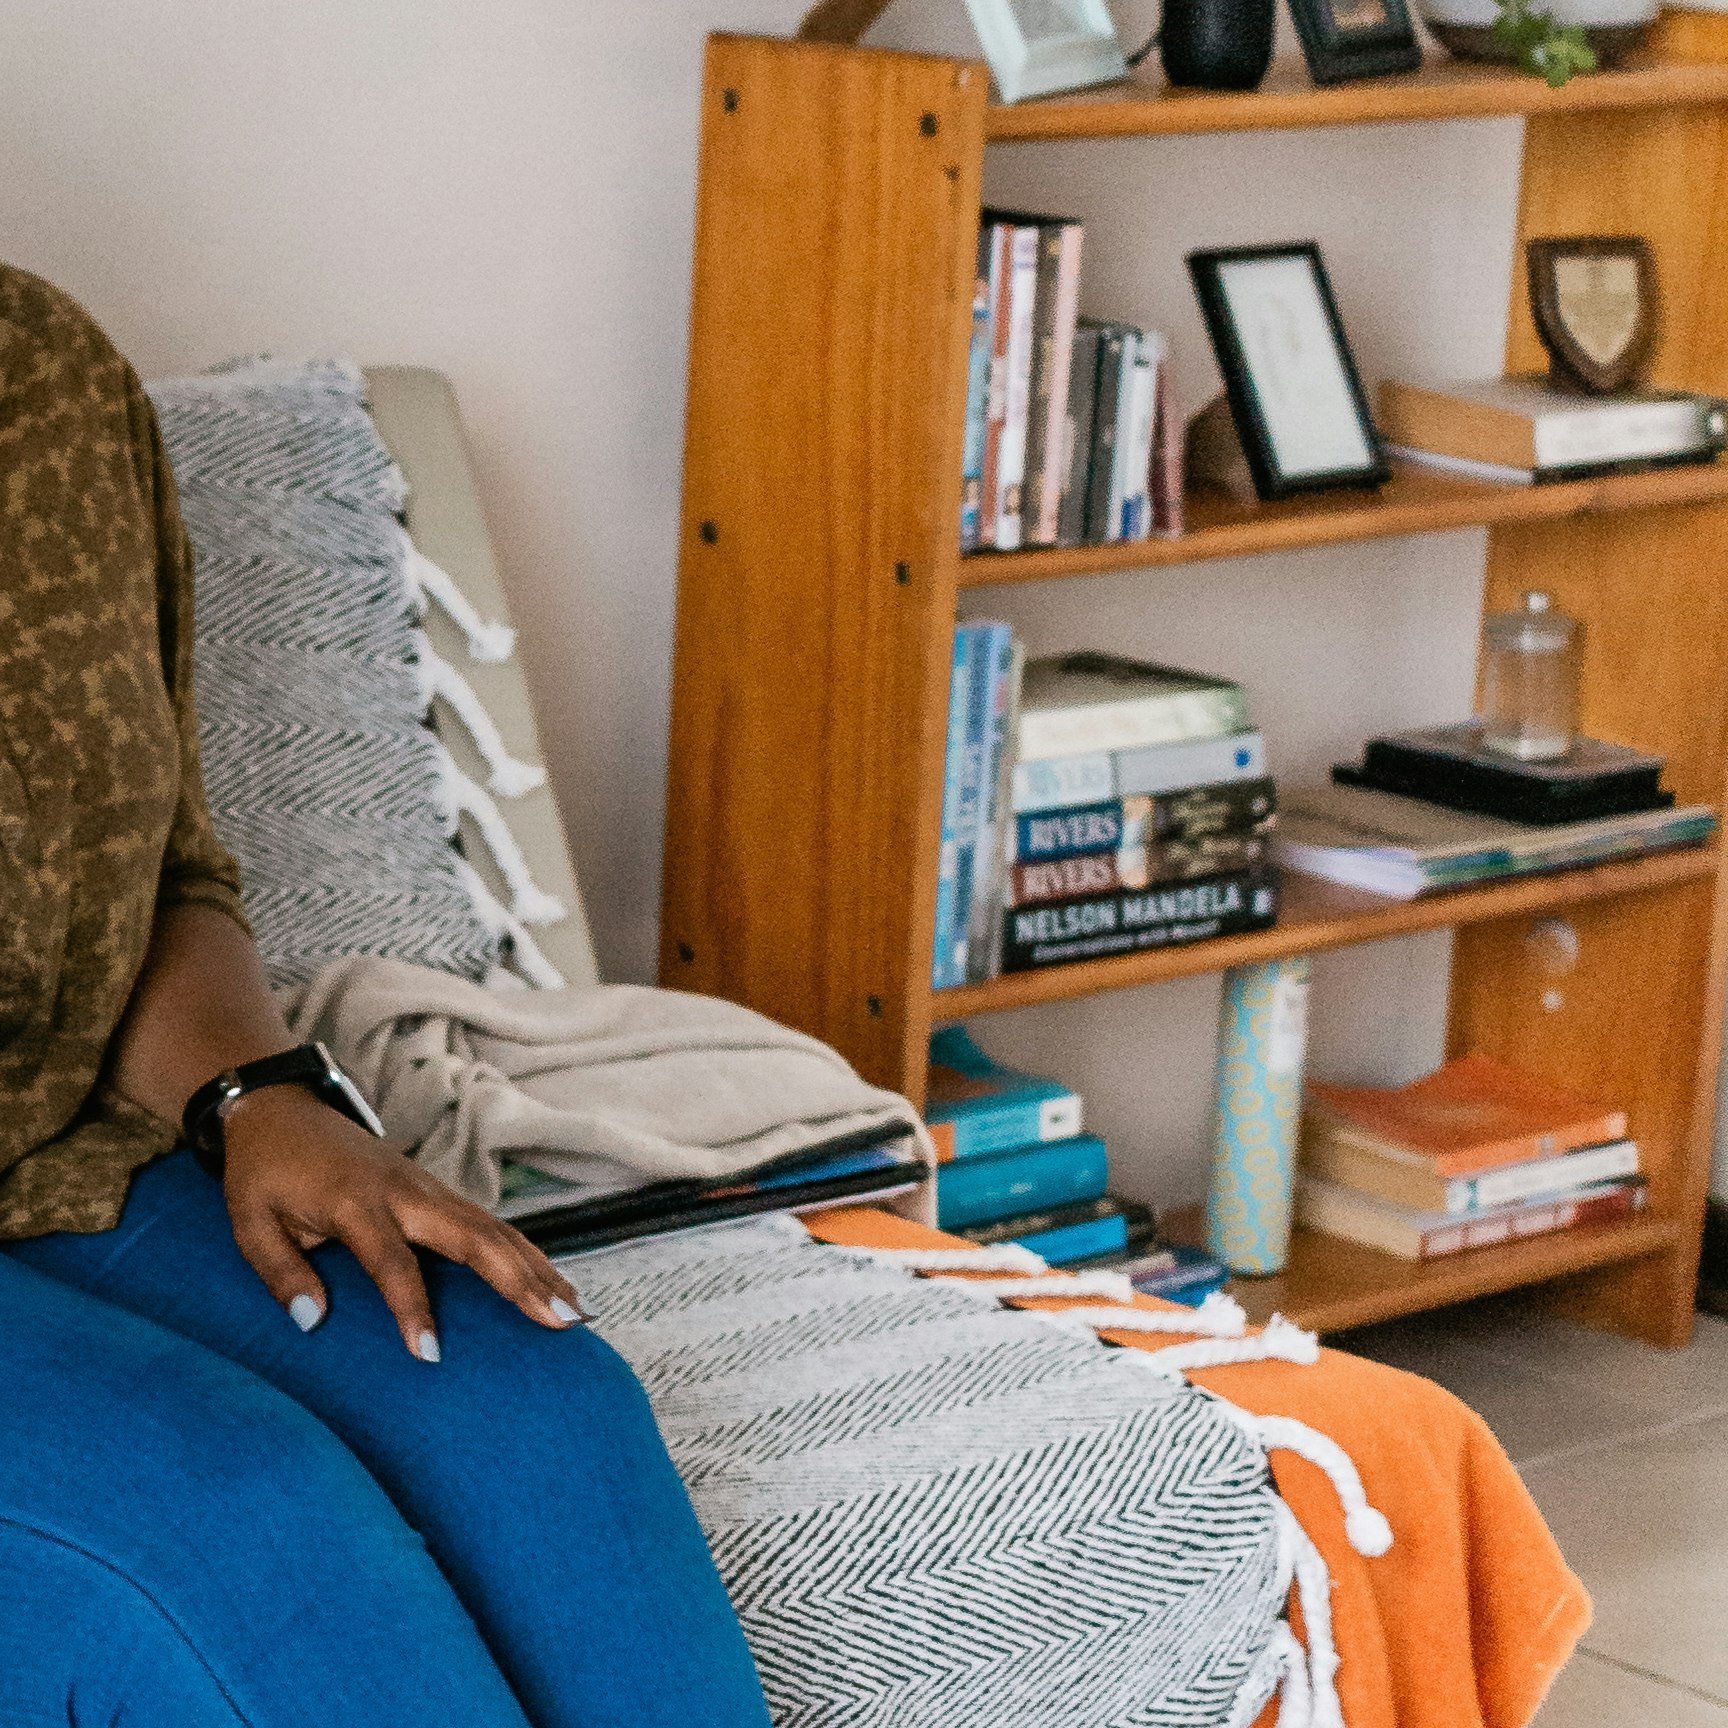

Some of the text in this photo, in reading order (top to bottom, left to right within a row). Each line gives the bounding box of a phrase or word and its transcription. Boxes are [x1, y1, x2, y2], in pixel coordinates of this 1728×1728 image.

[1029, 813, 1118, 852] RIVERS
[1023, 856, 1112, 898] RIVERS
[1016, 901, 1116, 943] NELSON
[1123, 884, 1241, 927] MANDELA
